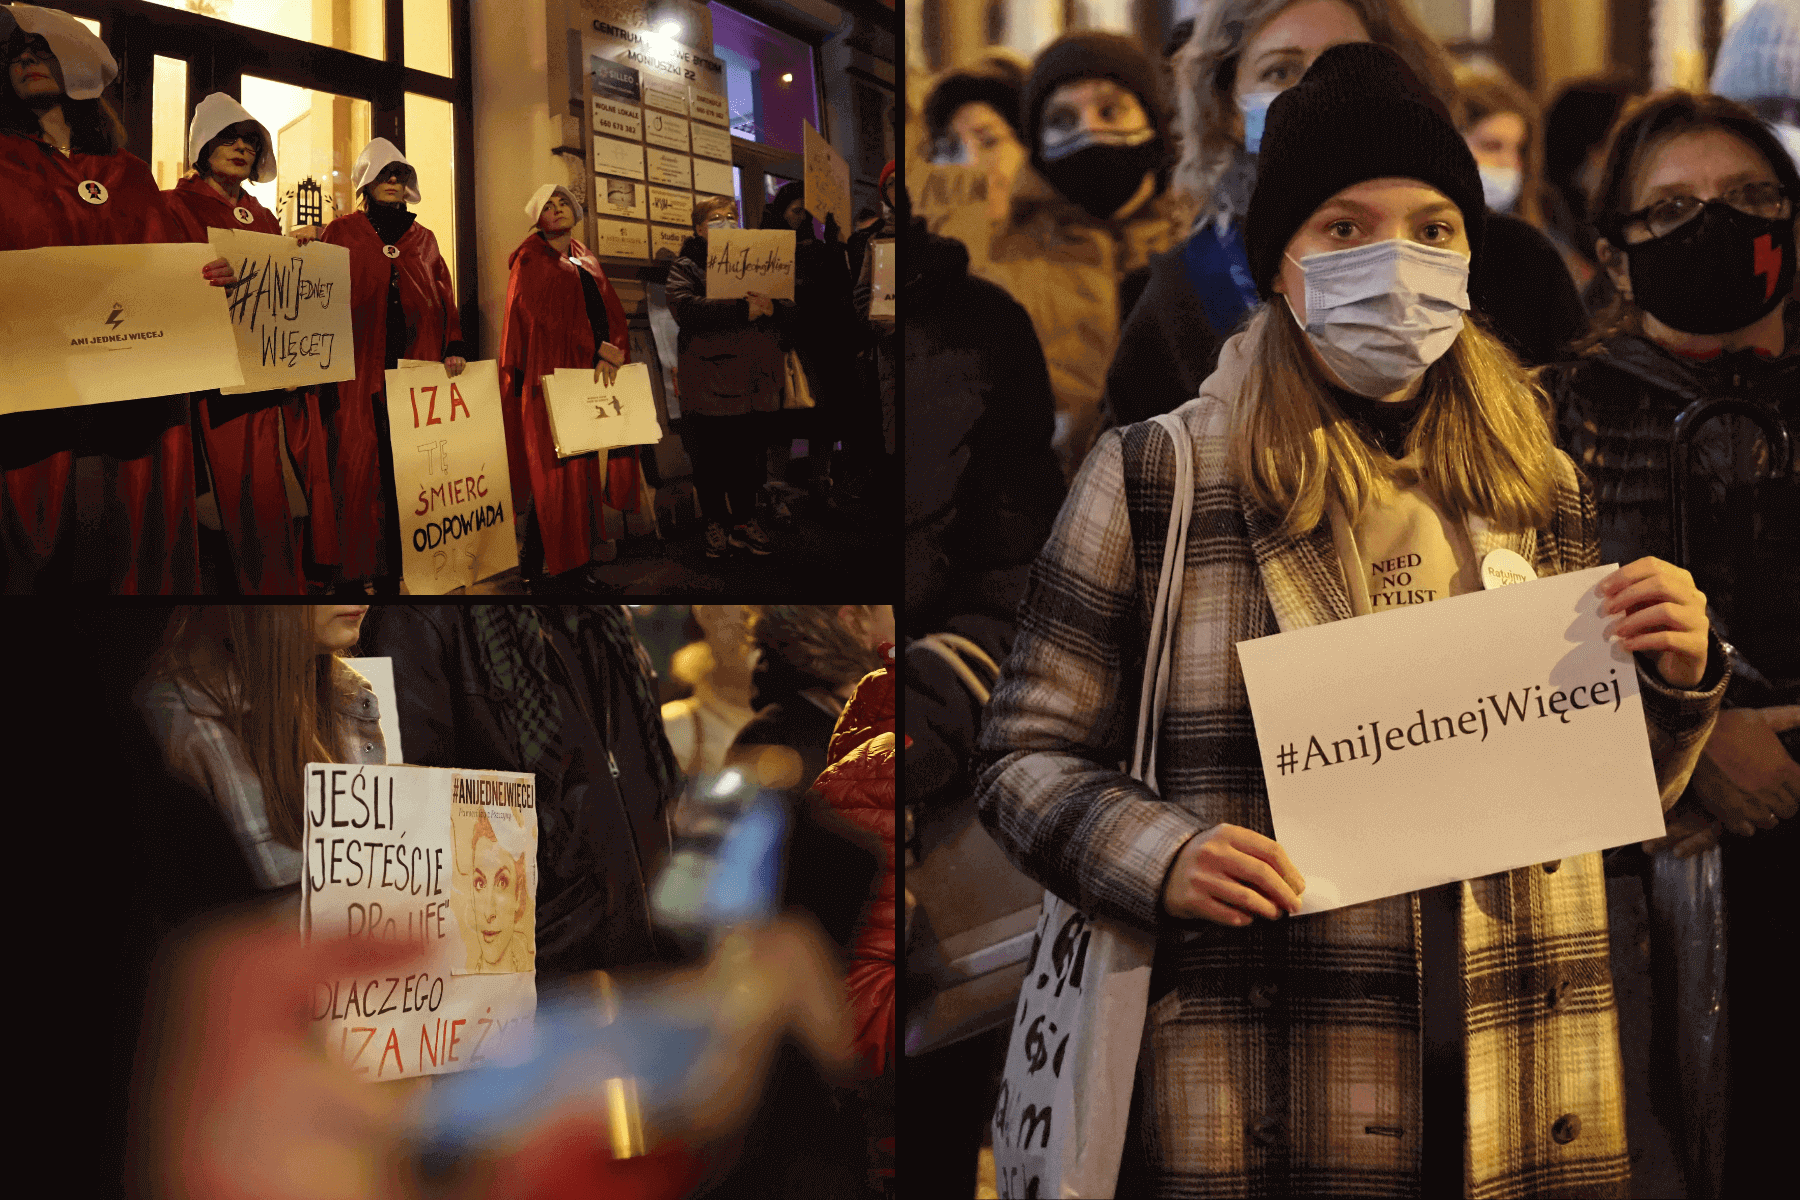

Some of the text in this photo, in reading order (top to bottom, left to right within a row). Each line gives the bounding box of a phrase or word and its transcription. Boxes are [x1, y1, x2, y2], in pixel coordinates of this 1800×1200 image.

[627, 49, 682, 76] MONIUSZKI
[684, 68, 696, 81] 22
[595, 102, 639, 119] WOLNE LOKALE
[70, 330, 164, 346] ANI JEDNEJ WIĘCEJ
[262, 324, 335, 370] WIĘCEJ
[409, 382, 471, 428] IZA
[417, 439, 449, 476] TĘ
[414, 462, 489, 517] ŚMIERĆ
[412, 500, 505, 553] ODPOWIADA
[1371, 553, 1422, 576] NEED
[1382, 571, 1412, 589] NO
[1370, 589, 1437, 607] TYLIST
[1276, 668, 1622, 776] #AniJednejWięcej
[310, 765, 394, 831] JEŚLI
[452, 777, 534, 813] #ANIJEDNEJWIĘCEJ
[311, 831, 443, 898] JESTEŚCIE
[312, 972, 444, 1022] DLACZEGO
[340, 1027, 404, 1078] IZA
[419, 1017, 467, 1073] NIE
